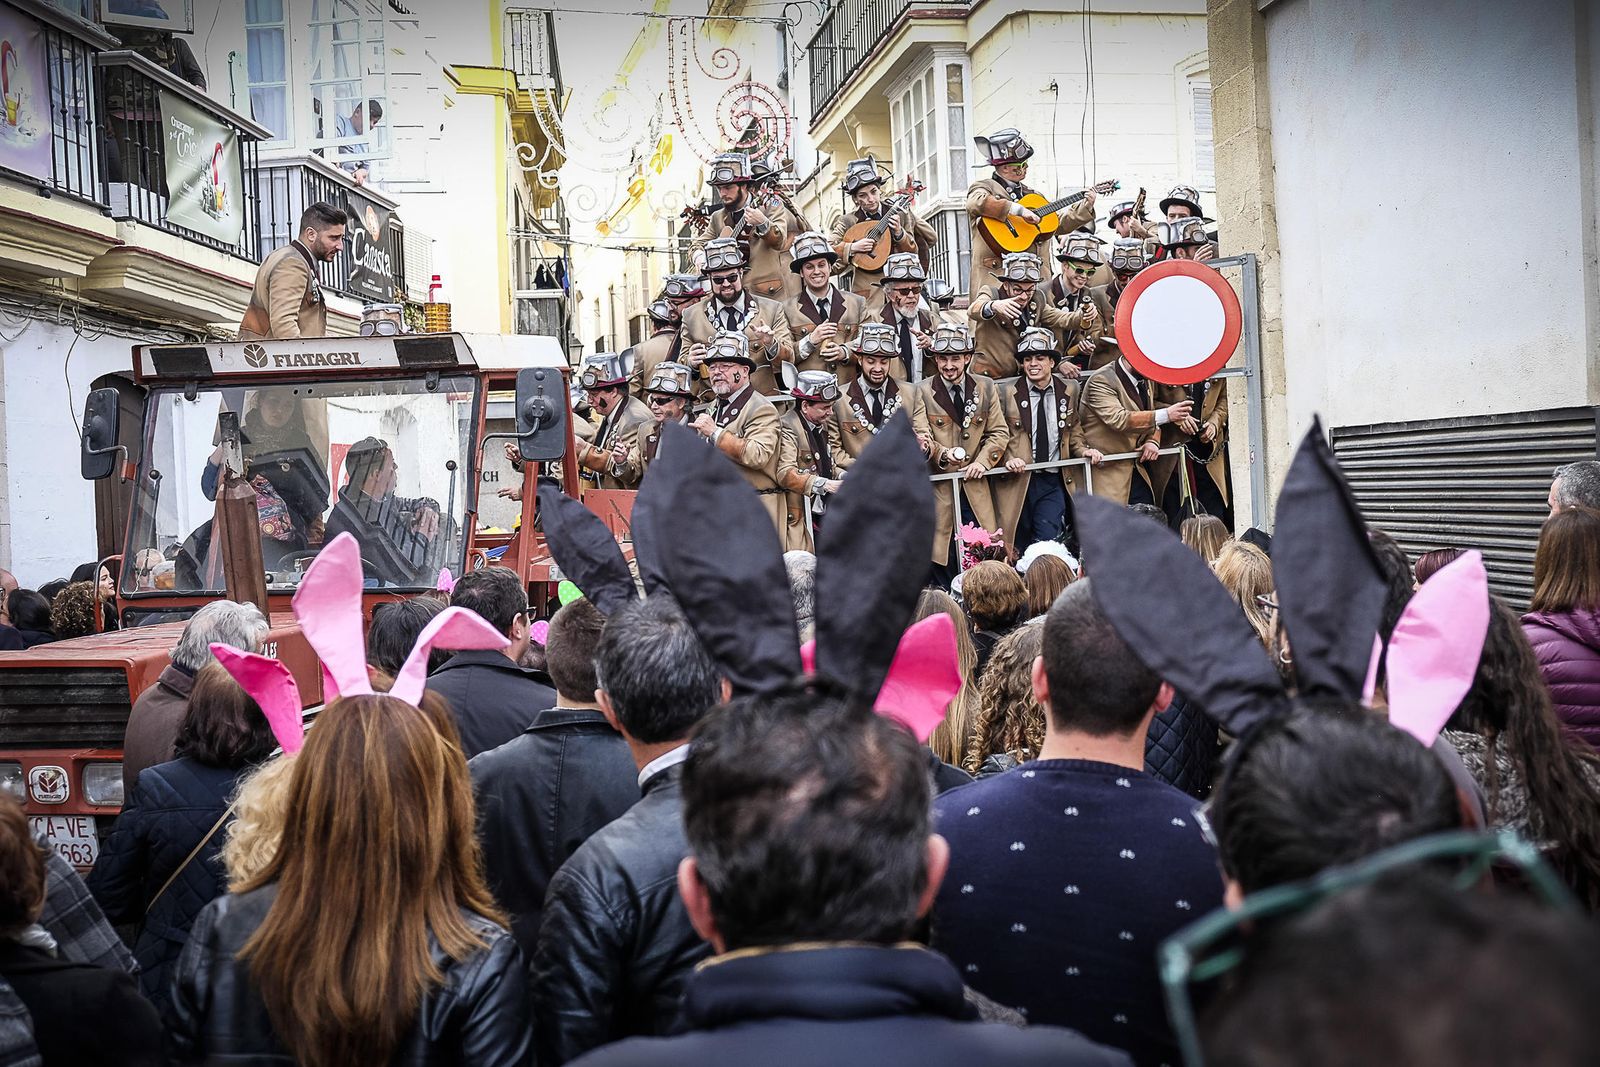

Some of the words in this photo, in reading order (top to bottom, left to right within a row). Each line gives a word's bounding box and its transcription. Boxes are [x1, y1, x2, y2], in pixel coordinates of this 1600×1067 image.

[352, 228, 392, 279] Canasta
[273, 352, 361, 367] FIATAGRI
[483, 471, 498, 482] CH
[55, 843, 93, 864] 663
